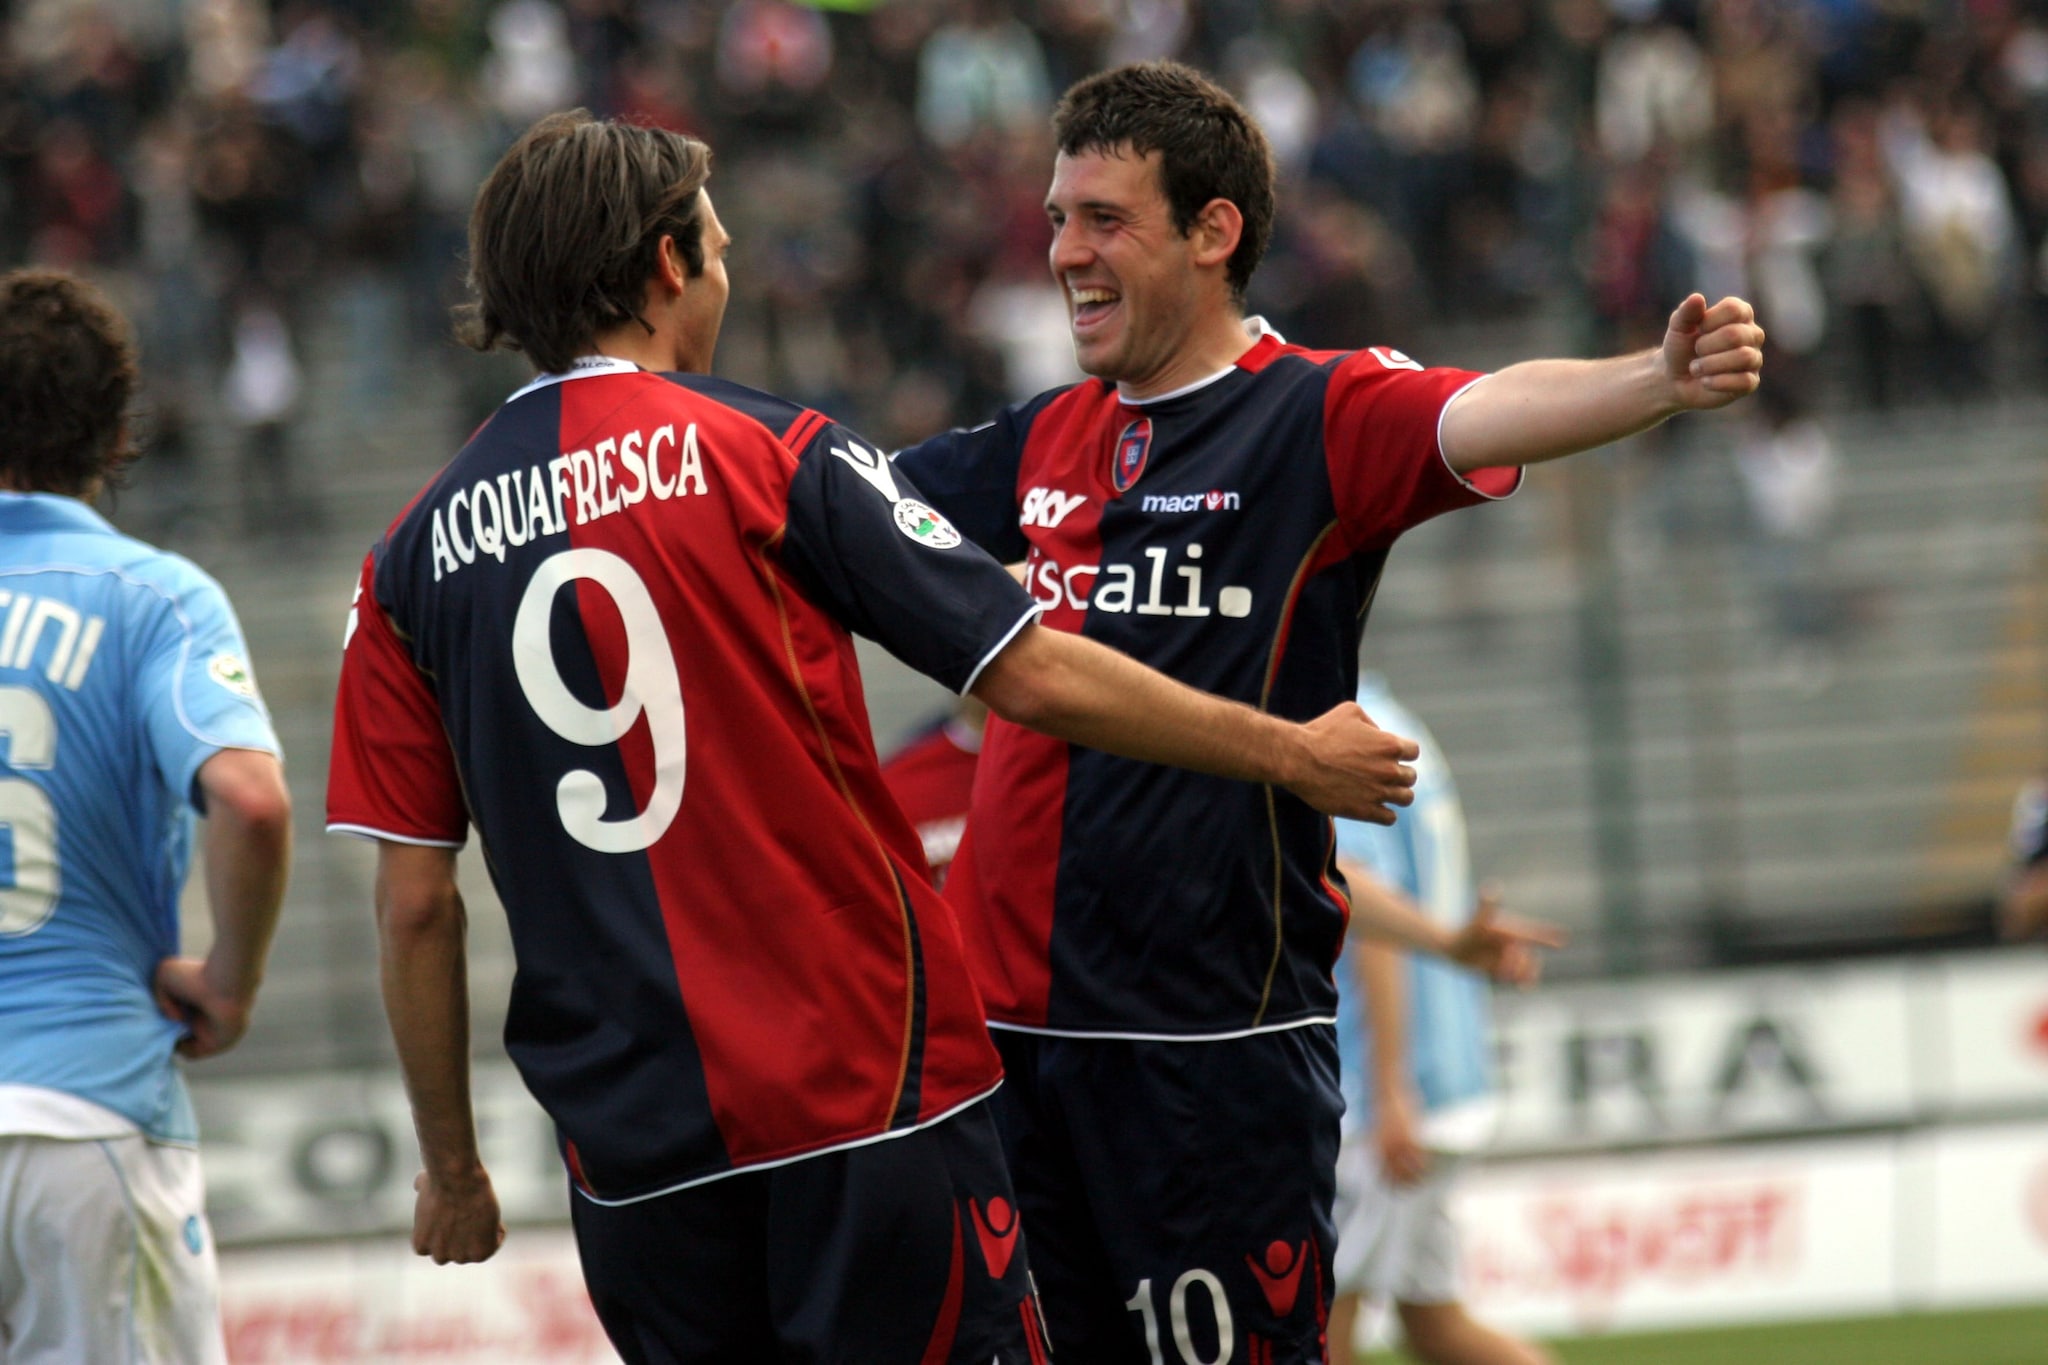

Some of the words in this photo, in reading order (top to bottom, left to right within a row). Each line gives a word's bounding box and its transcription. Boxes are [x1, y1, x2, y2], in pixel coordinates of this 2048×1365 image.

[431, 423, 707, 582] ACQUAFRESCA
[1141, 491, 1240, 513] macron
[512, 547, 686, 853] 9
[1125, 1268, 1234, 1365] 10
